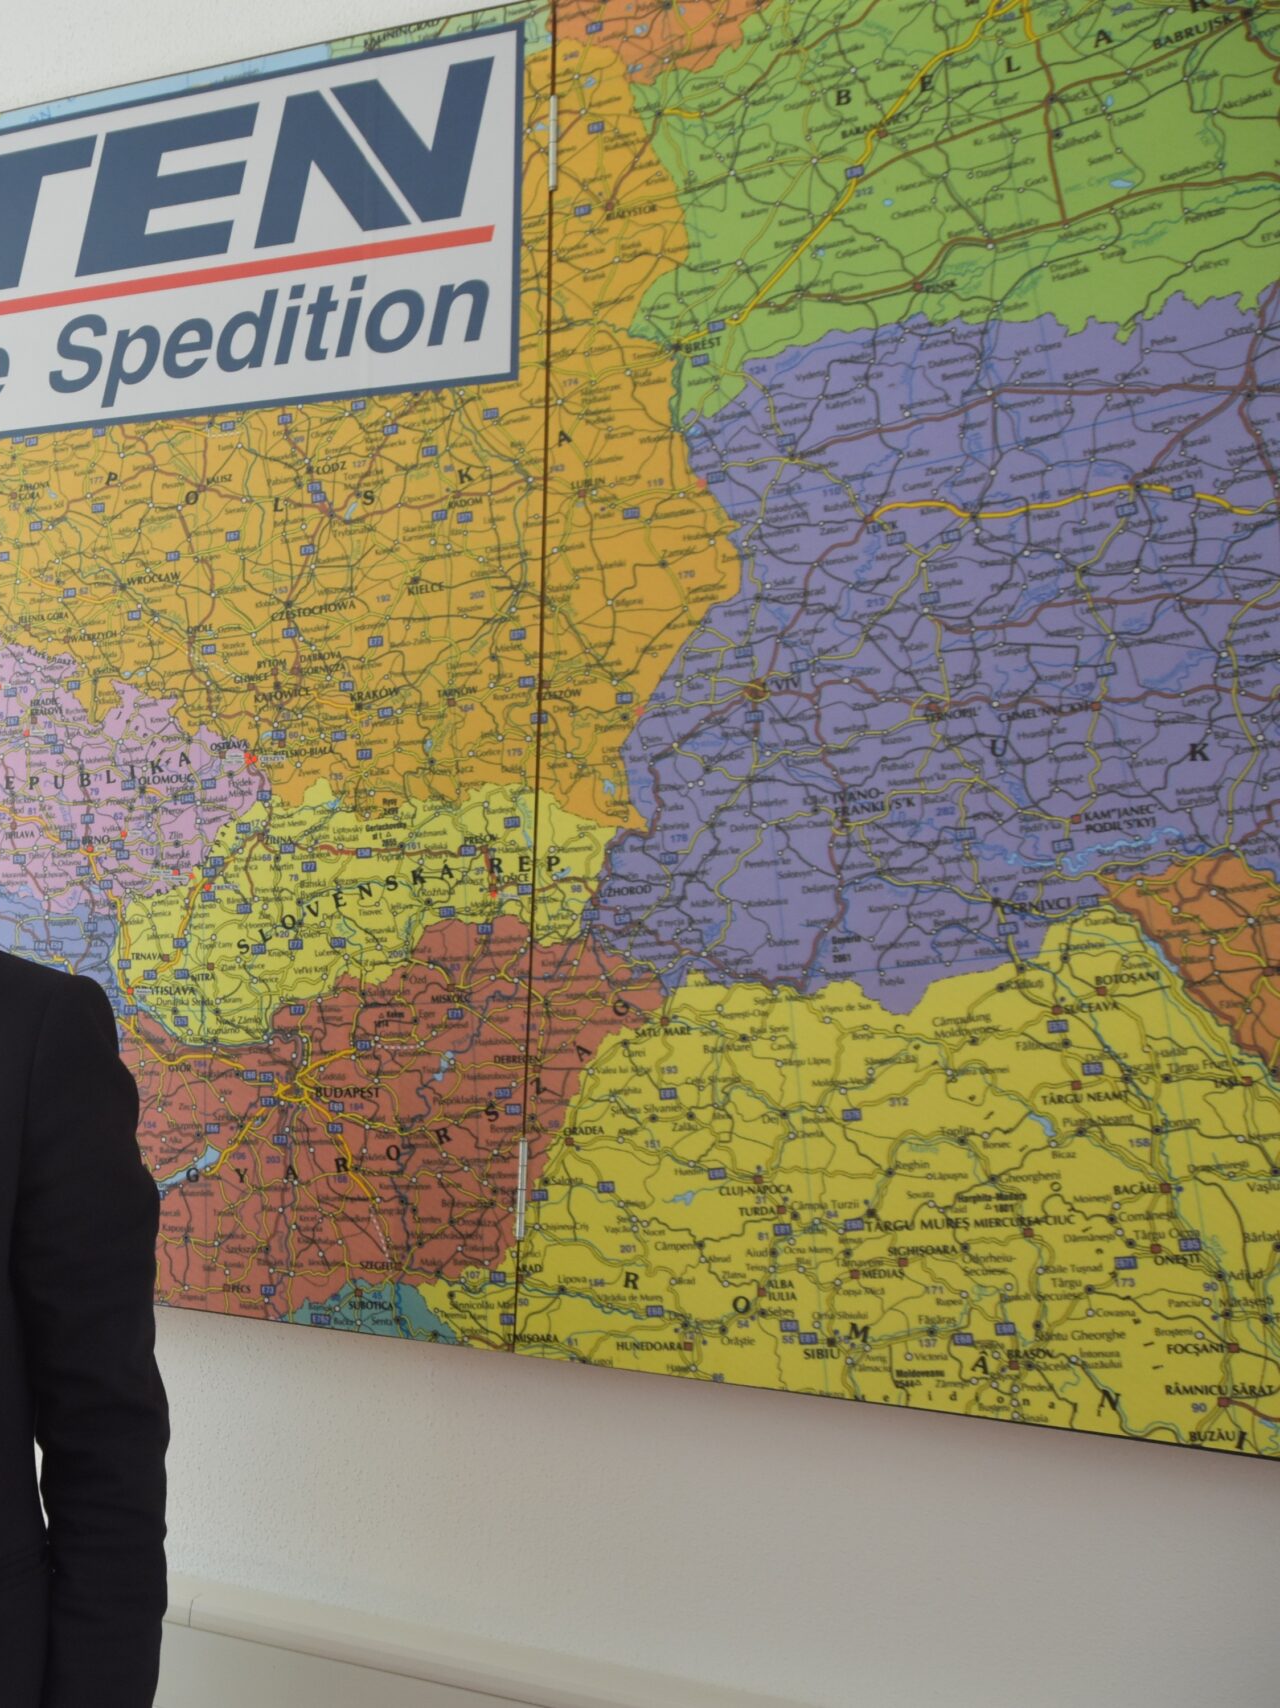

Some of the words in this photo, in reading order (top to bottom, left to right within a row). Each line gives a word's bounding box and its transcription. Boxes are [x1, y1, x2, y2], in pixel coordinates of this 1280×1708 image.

[1152, 13, 1233, 50] BABRUJSK
[48, 276, 490, 407] Spedition
[684, 336, 722, 352] BREST
[350, 687, 400, 702] KRAKÓW
[138, 774, 194, 786] OLOMOUC
[316, 1087, 380, 1099] BUDAPEST
[1041, 1093, 1084, 1105] TÂRGU
[564, 1126, 604, 1136] ORADEA
[1051, 1150, 1076, 1159] Bicaz
[1001, 1171, 1061, 1184] Gheorgheni
[719, 1184, 792, 1196] CLUJ-NAPOCA
[832, 1199, 859, 1209] Turzii
[739, 1207, 776, 1216] TURDA
[866, 1220, 915, 1232] TÂRGU
[746, 1248, 768, 1258] Aiud
[558, 1275, 587, 1286] Lipova
[768, 1280, 794, 1289] ALBA
[769, 1291, 797, 1301] IULIA
[348, 1302, 394, 1311] SUBOTICA
[1071, 1330, 1126, 1341] Gheorghe
[616, 1341, 682, 1352] HUNEDOARA
[803, 1349, 840, 1360] SIBIU
[1164, 1384, 1228, 1396] RÂMNICU
